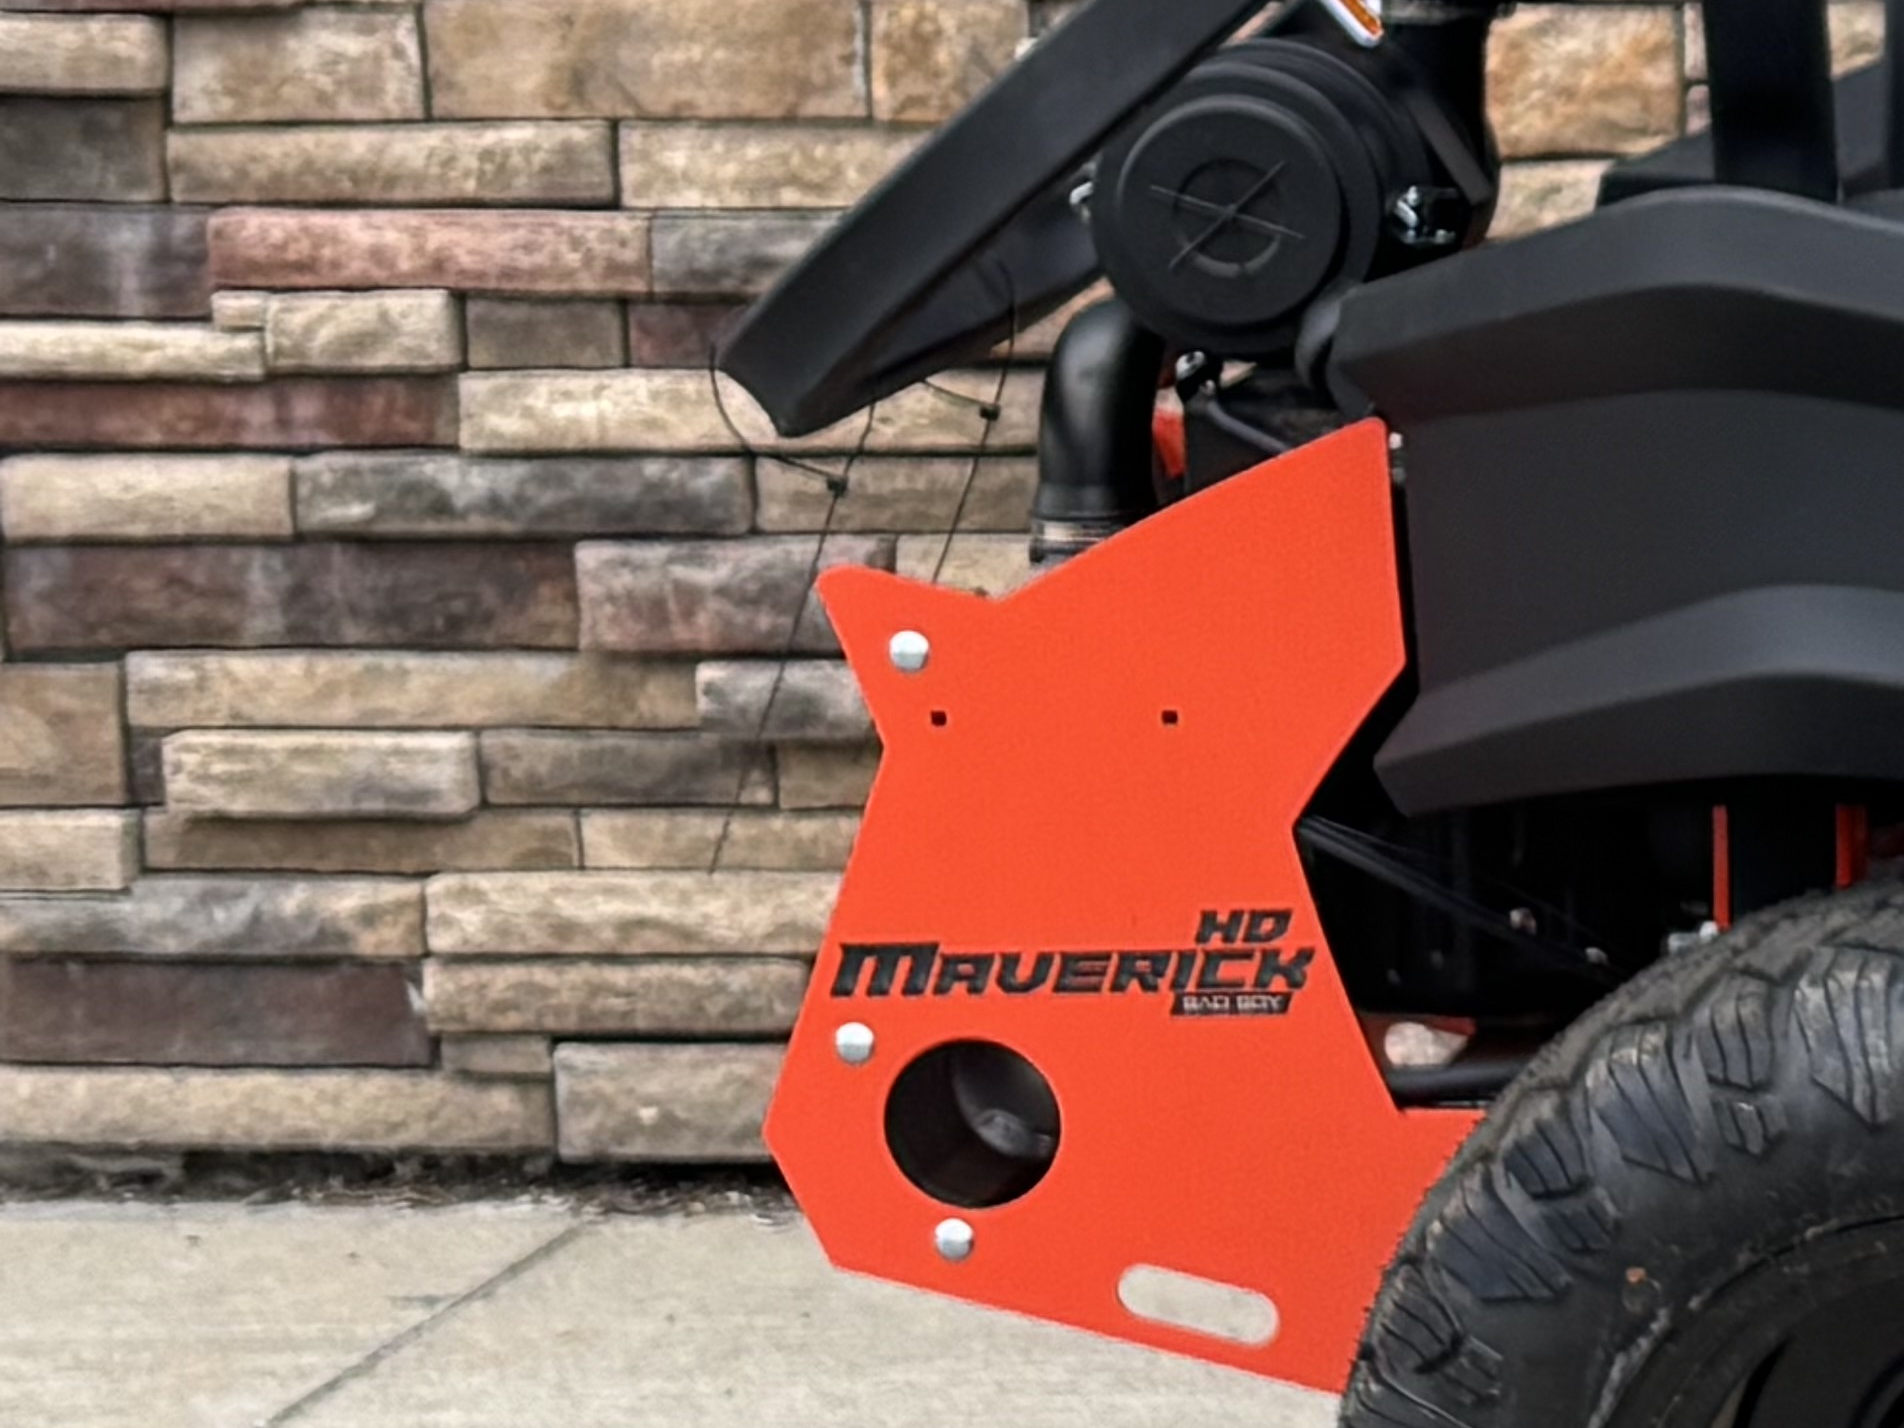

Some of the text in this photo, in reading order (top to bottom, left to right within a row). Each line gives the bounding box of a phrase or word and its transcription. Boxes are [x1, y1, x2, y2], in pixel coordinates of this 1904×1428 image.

[1195, 908, 1293, 945] HD
[829, 941, 1316, 998] MAVERICK
[1182, 994, 1284, 1011] BAD BOY
